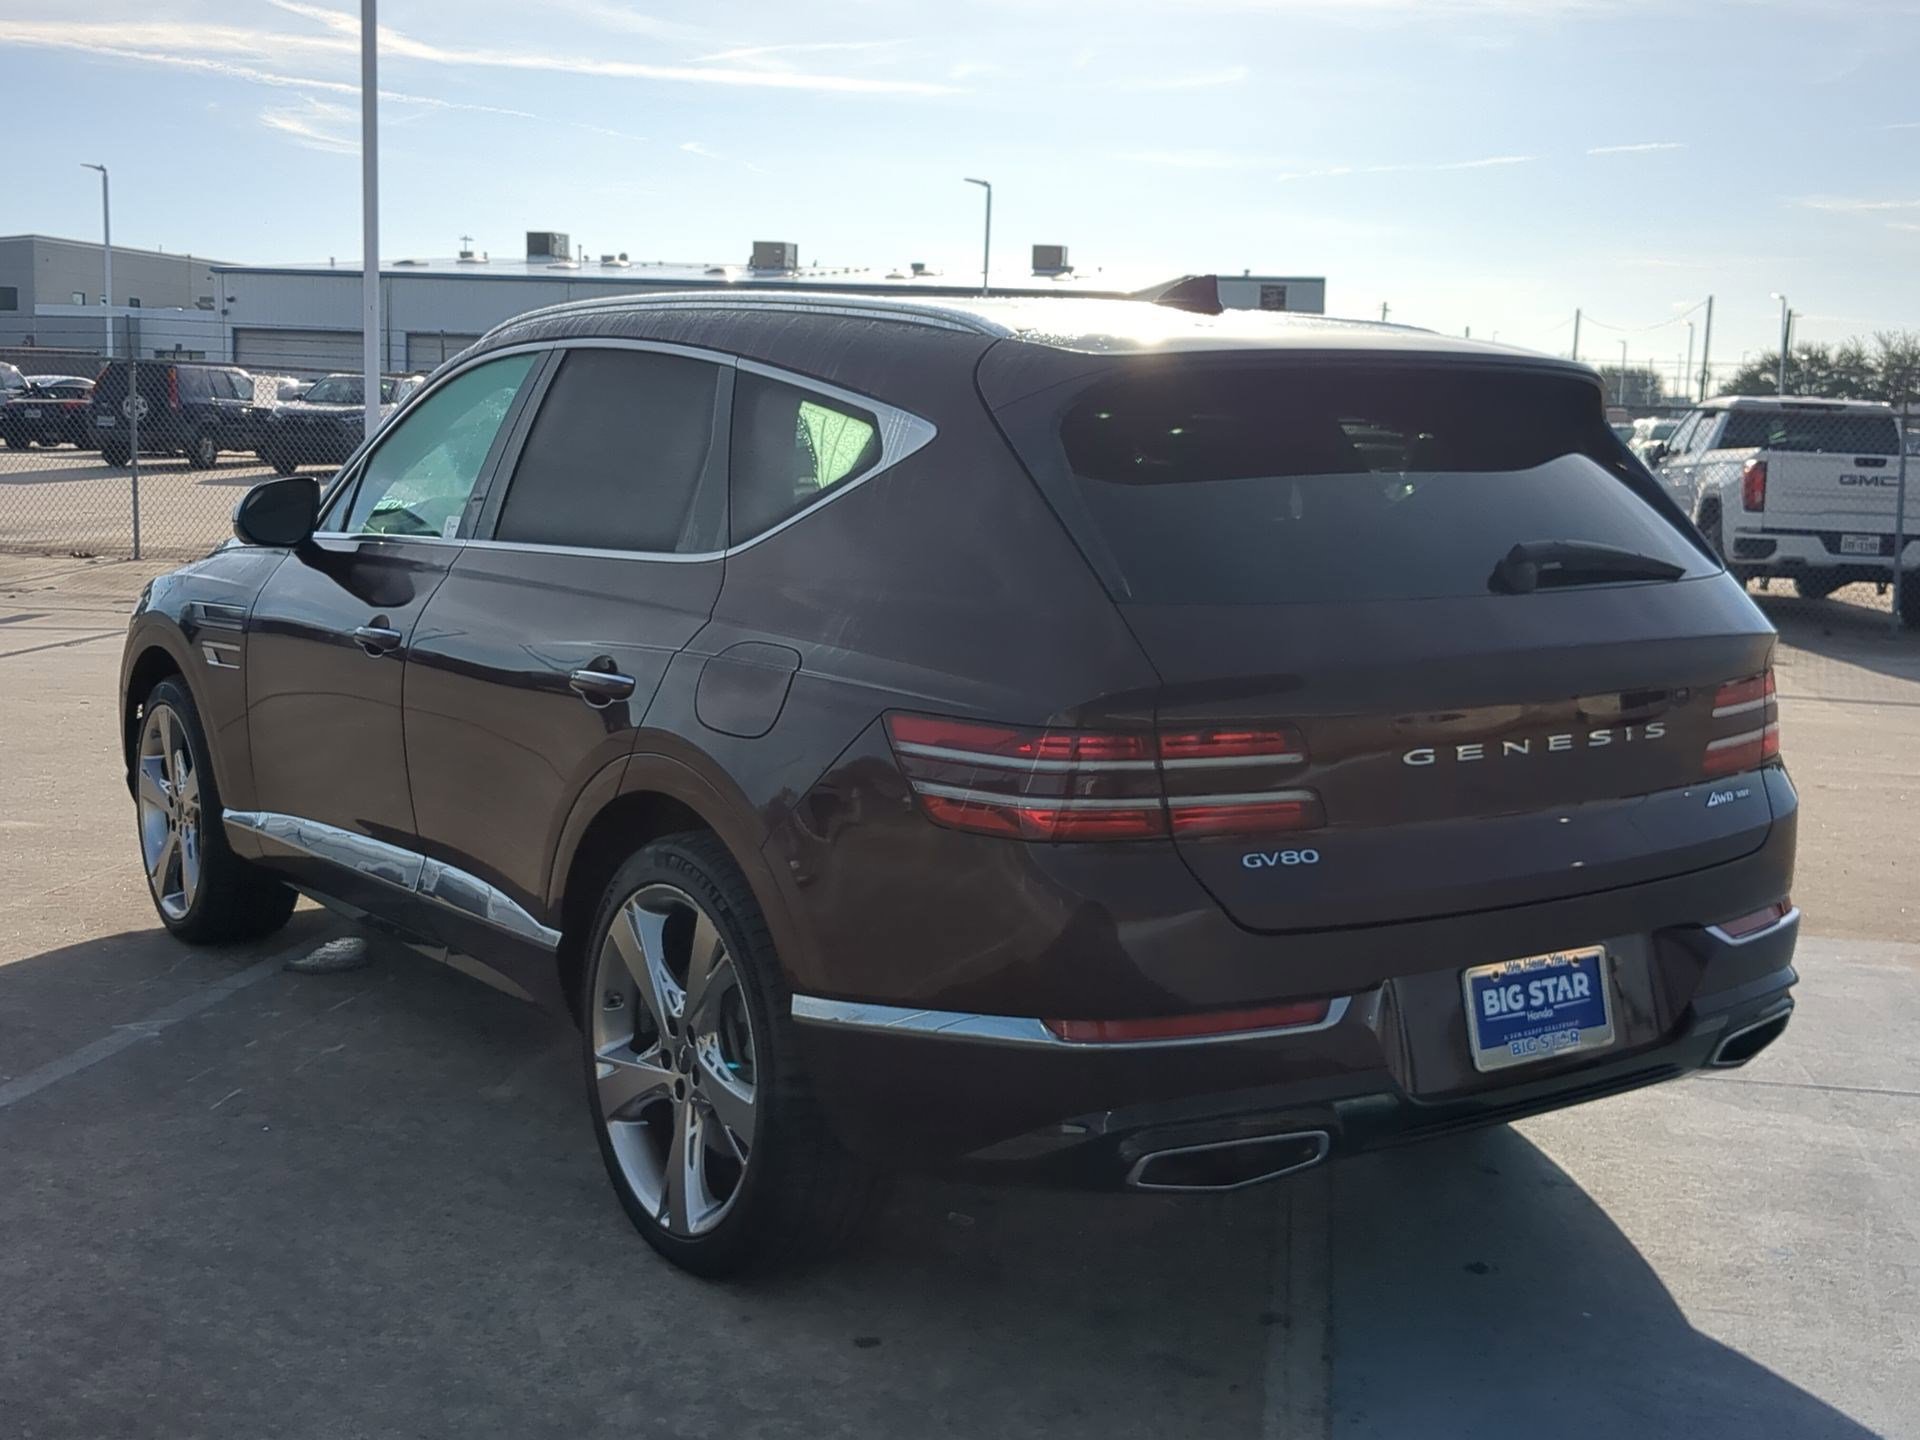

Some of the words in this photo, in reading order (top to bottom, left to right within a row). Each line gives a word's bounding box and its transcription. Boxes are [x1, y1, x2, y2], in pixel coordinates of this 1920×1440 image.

[1839, 474, 1899, 488] GMC
[1402, 722, 1666, 766] GENESIS
[1242, 849, 1320, 869] GV80
[1482, 984, 1525, 1016] BIG
[1528, 972, 1591, 1007] STAR
[1526, 1007, 1554, 1022] Honda
[1511, 1037, 1537, 1056] BIG
[1539, 1029, 1579, 1050] STAR
